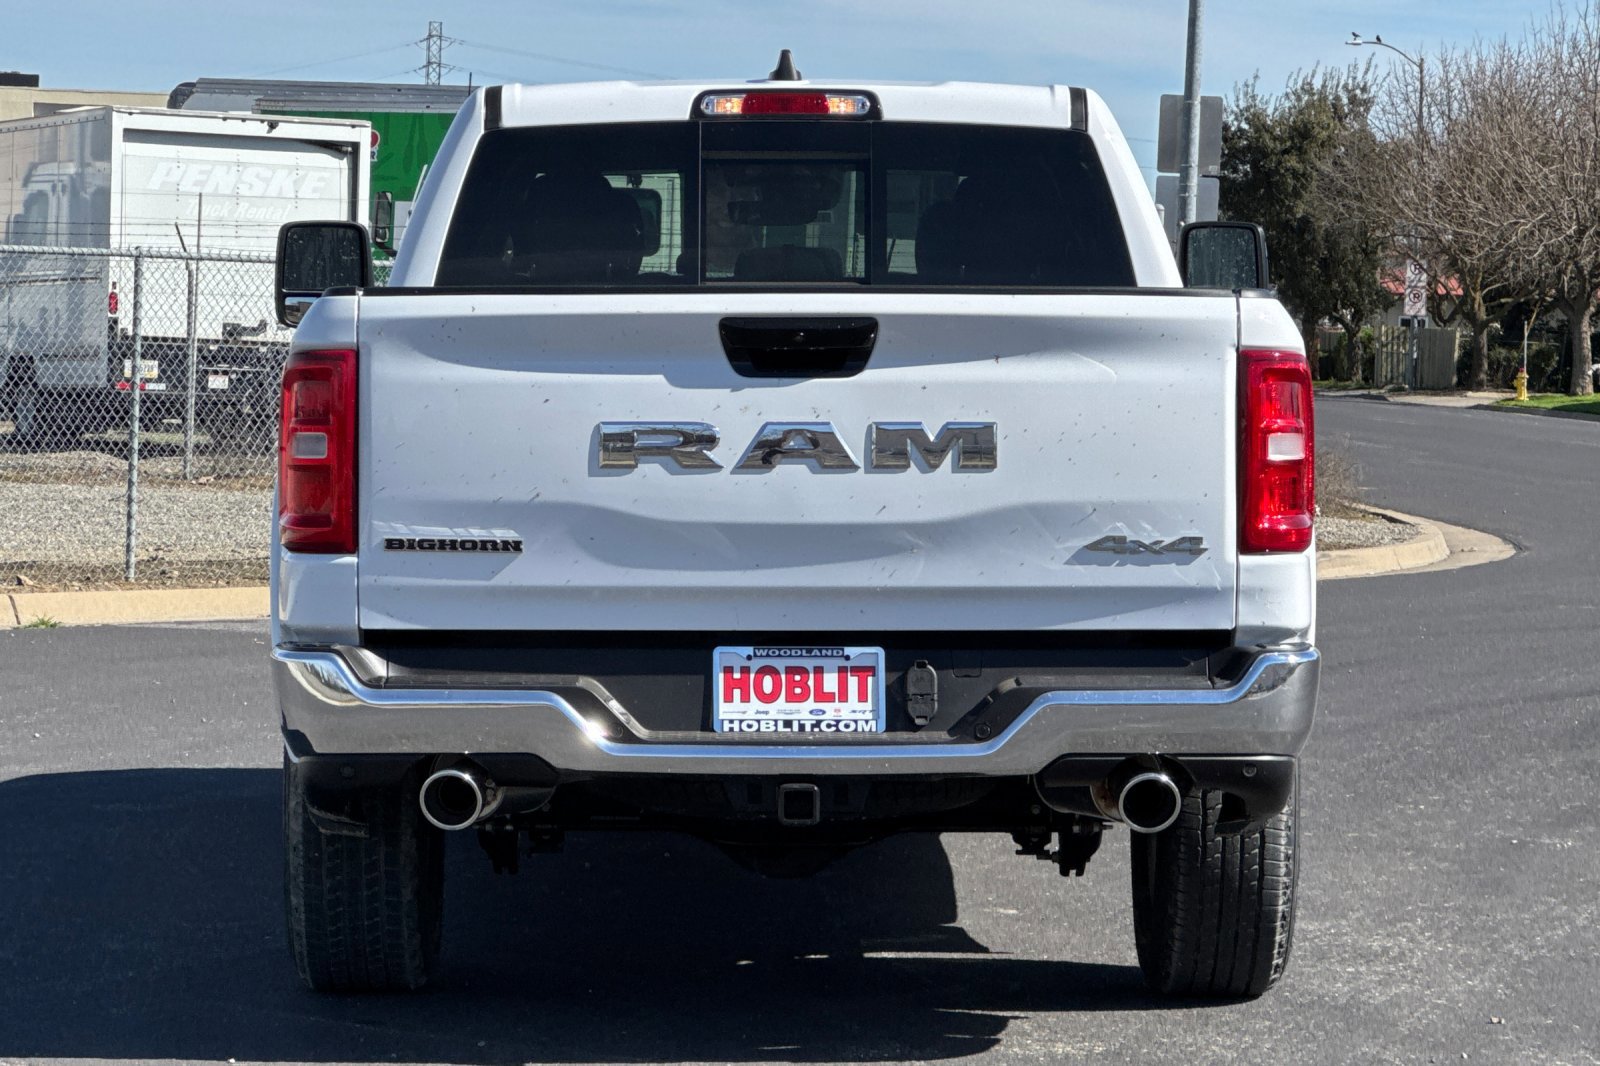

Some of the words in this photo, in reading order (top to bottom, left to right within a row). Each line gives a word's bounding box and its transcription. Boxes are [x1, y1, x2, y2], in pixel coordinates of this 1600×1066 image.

[148, 161, 332, 198] PENSKE
[185, 199, 231, 217] Truck
[234, 202, 292, 220] Rental
[599, 421, 998, 469] RAM
[384, 537, 523, 552] BIGHORN
[754, 648, 843, 657] WOODLAND
[723, 665, 876, 704] HOBLIT
[723, 719, 877, 732] HOBLIT.COM
